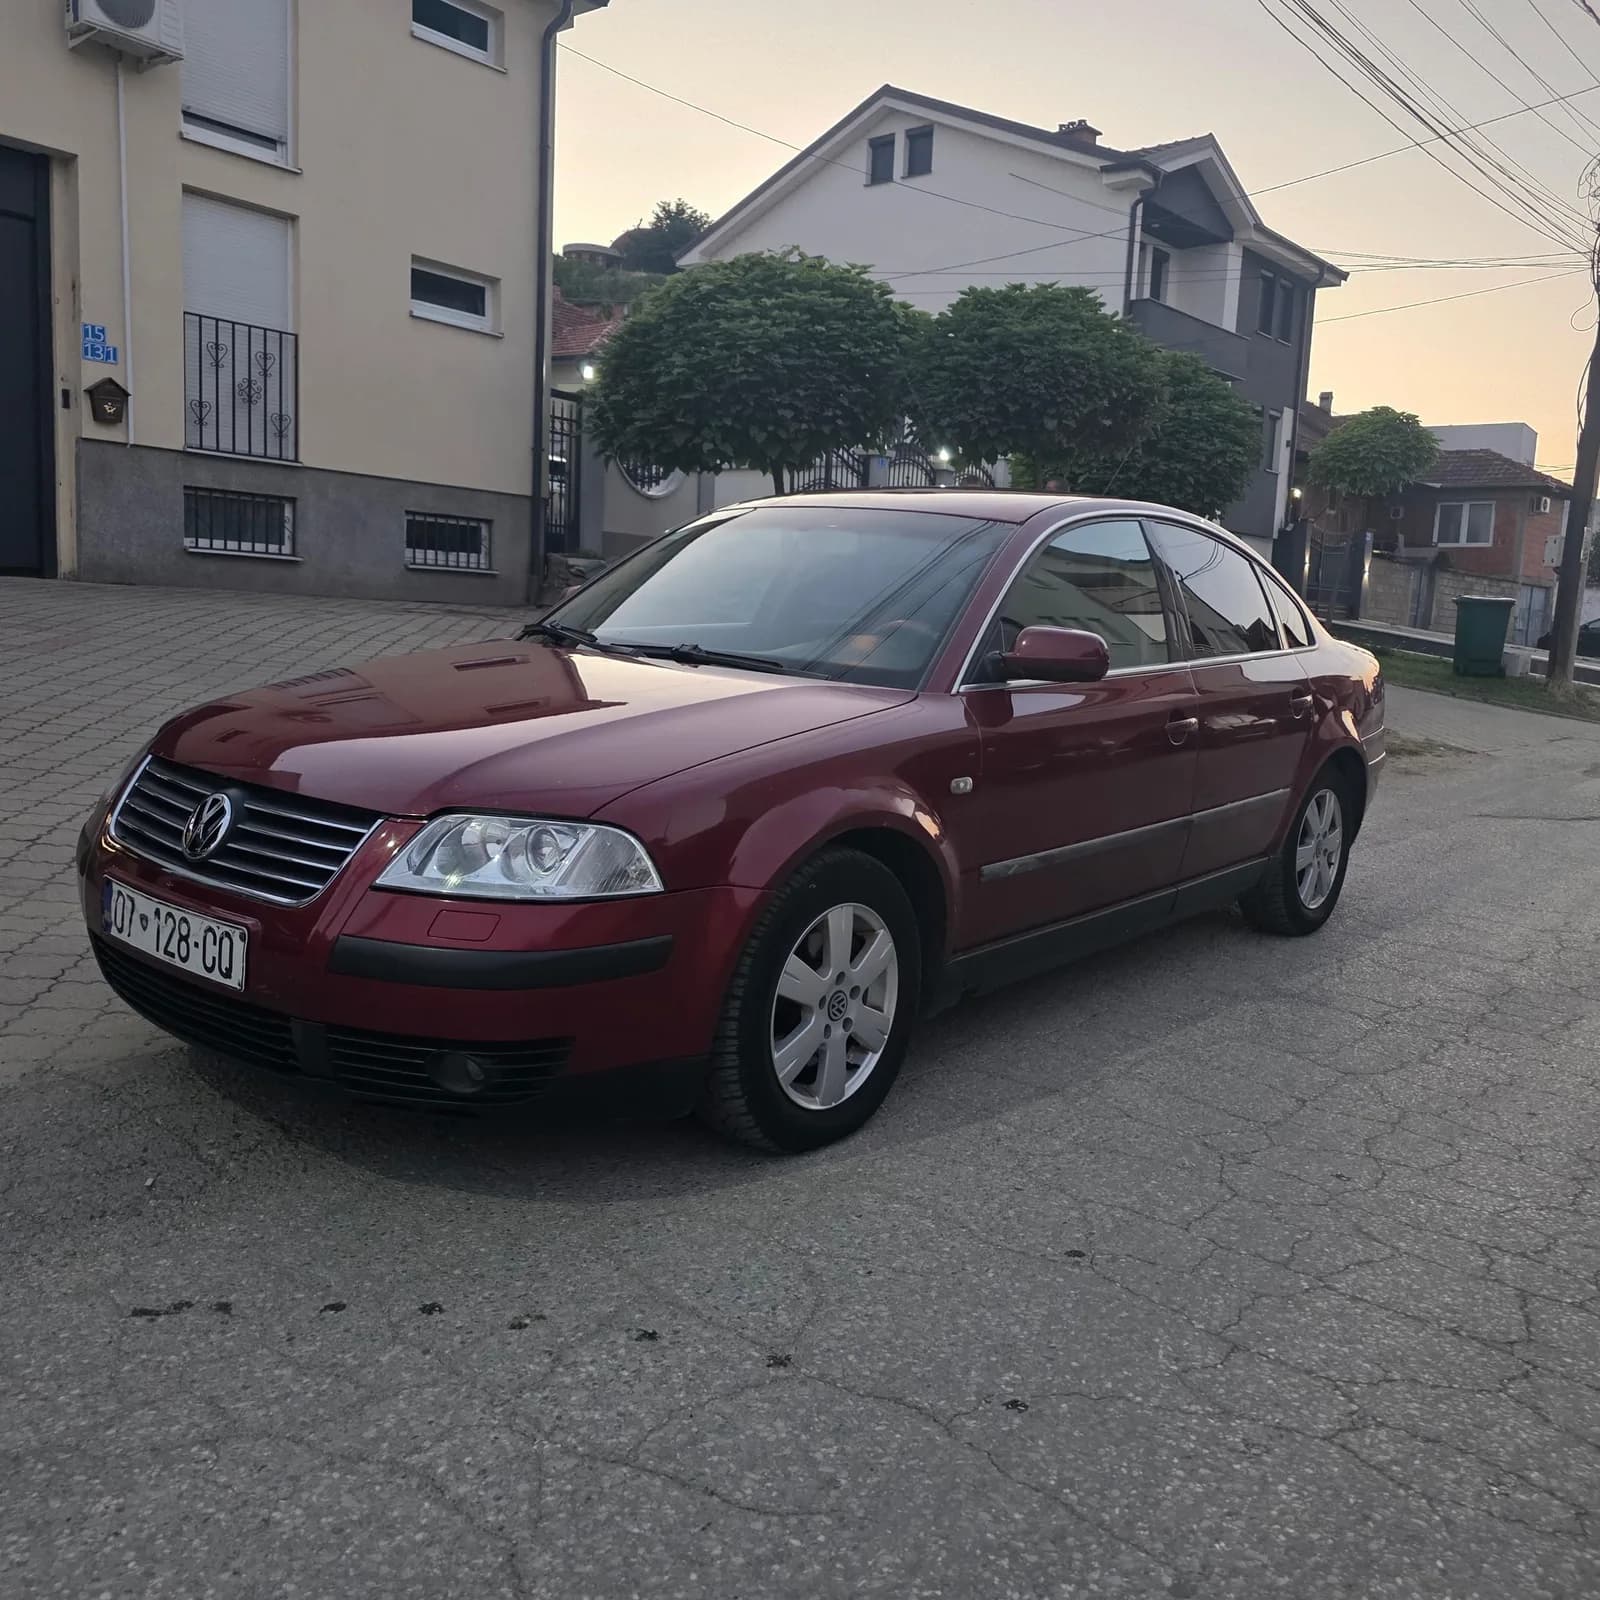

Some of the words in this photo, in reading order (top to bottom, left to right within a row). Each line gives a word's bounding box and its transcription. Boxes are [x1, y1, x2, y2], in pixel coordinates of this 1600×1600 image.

[84, 325, 104, 342] 15
[114, 890, 135, 937] 07
[154, 907, 234, 979] 128-CQ
